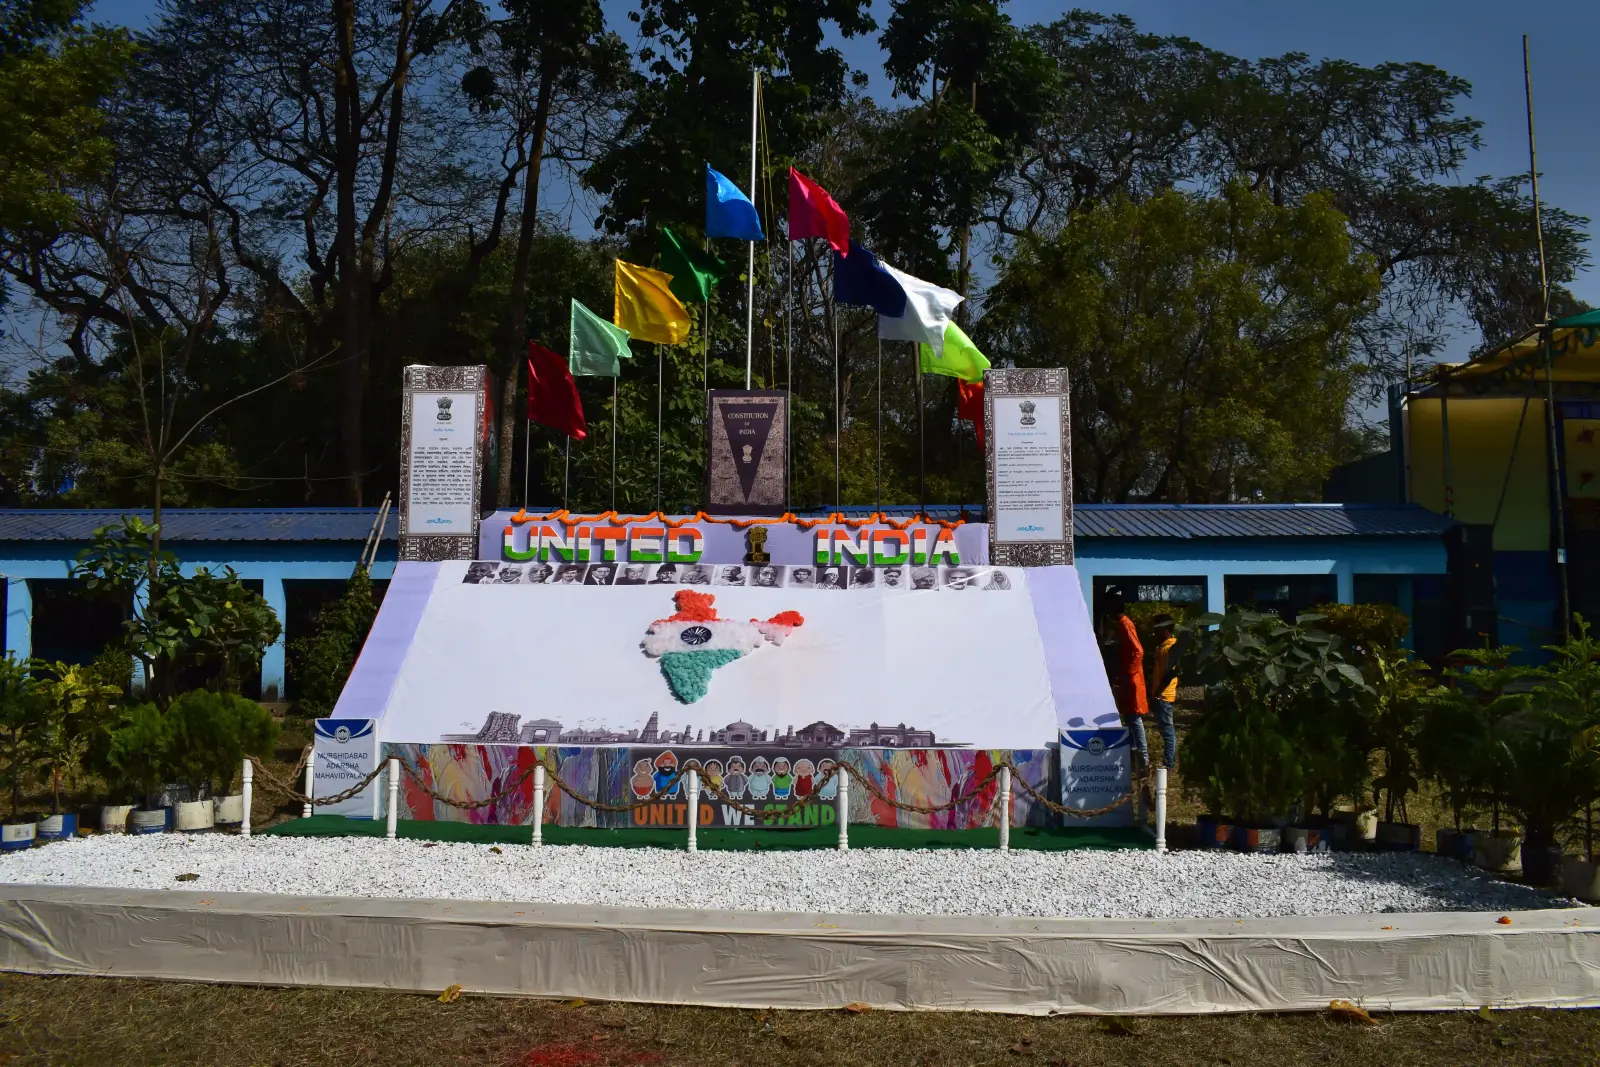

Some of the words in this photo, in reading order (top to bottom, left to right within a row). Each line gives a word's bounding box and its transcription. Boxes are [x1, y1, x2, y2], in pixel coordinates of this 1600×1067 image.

[504, 525, 704, 563] UNITED
[815, 527, 961, 565] INDIA
[317, 752, 368, 760] MURSHIDABAD
[1068, 764, 1124, 772] MURSHIDABAD
[315, 772, 370, 780] MAHAVIDYALAY
[1079, 775, 1116, 783] ADARSHA
[634, 804, 715, 826] UNITD
[721, 804, 755, 826] WE
